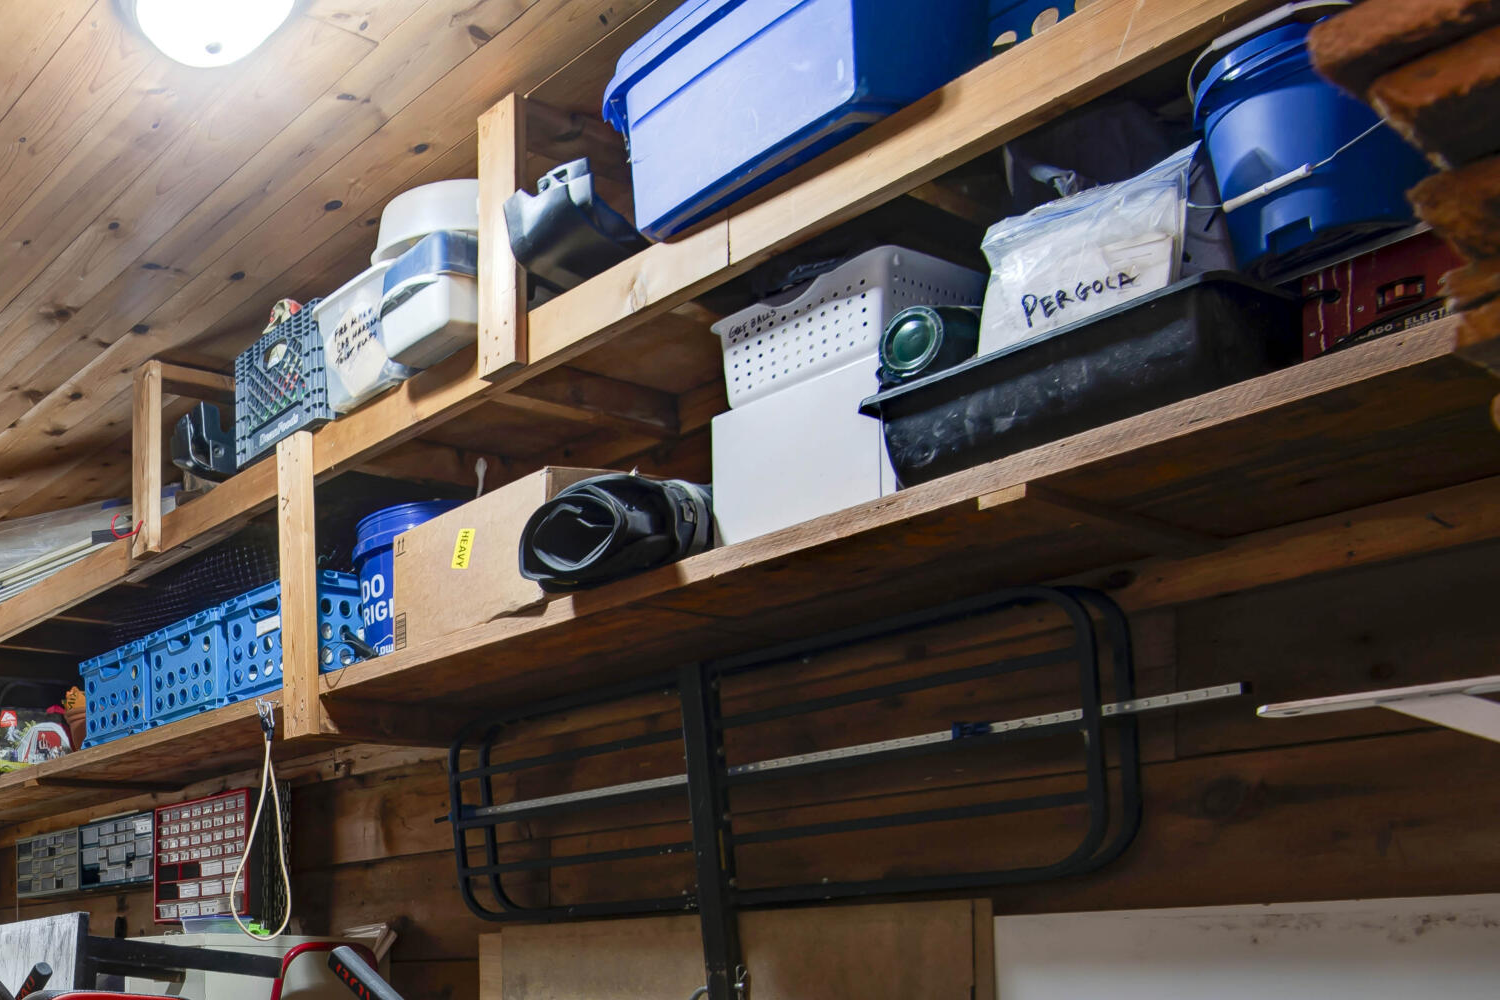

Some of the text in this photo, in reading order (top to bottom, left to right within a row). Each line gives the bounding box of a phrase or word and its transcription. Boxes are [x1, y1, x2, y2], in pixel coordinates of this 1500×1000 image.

[1021, 271, 1141, 329] PERGOLA
[728, 308, 777, 339] GOLF BALLS
[1404, 307, 1451, 326] ELECT
[455, 530, 470, 568] HEAVY
[361, 573, 385, 605] DO
